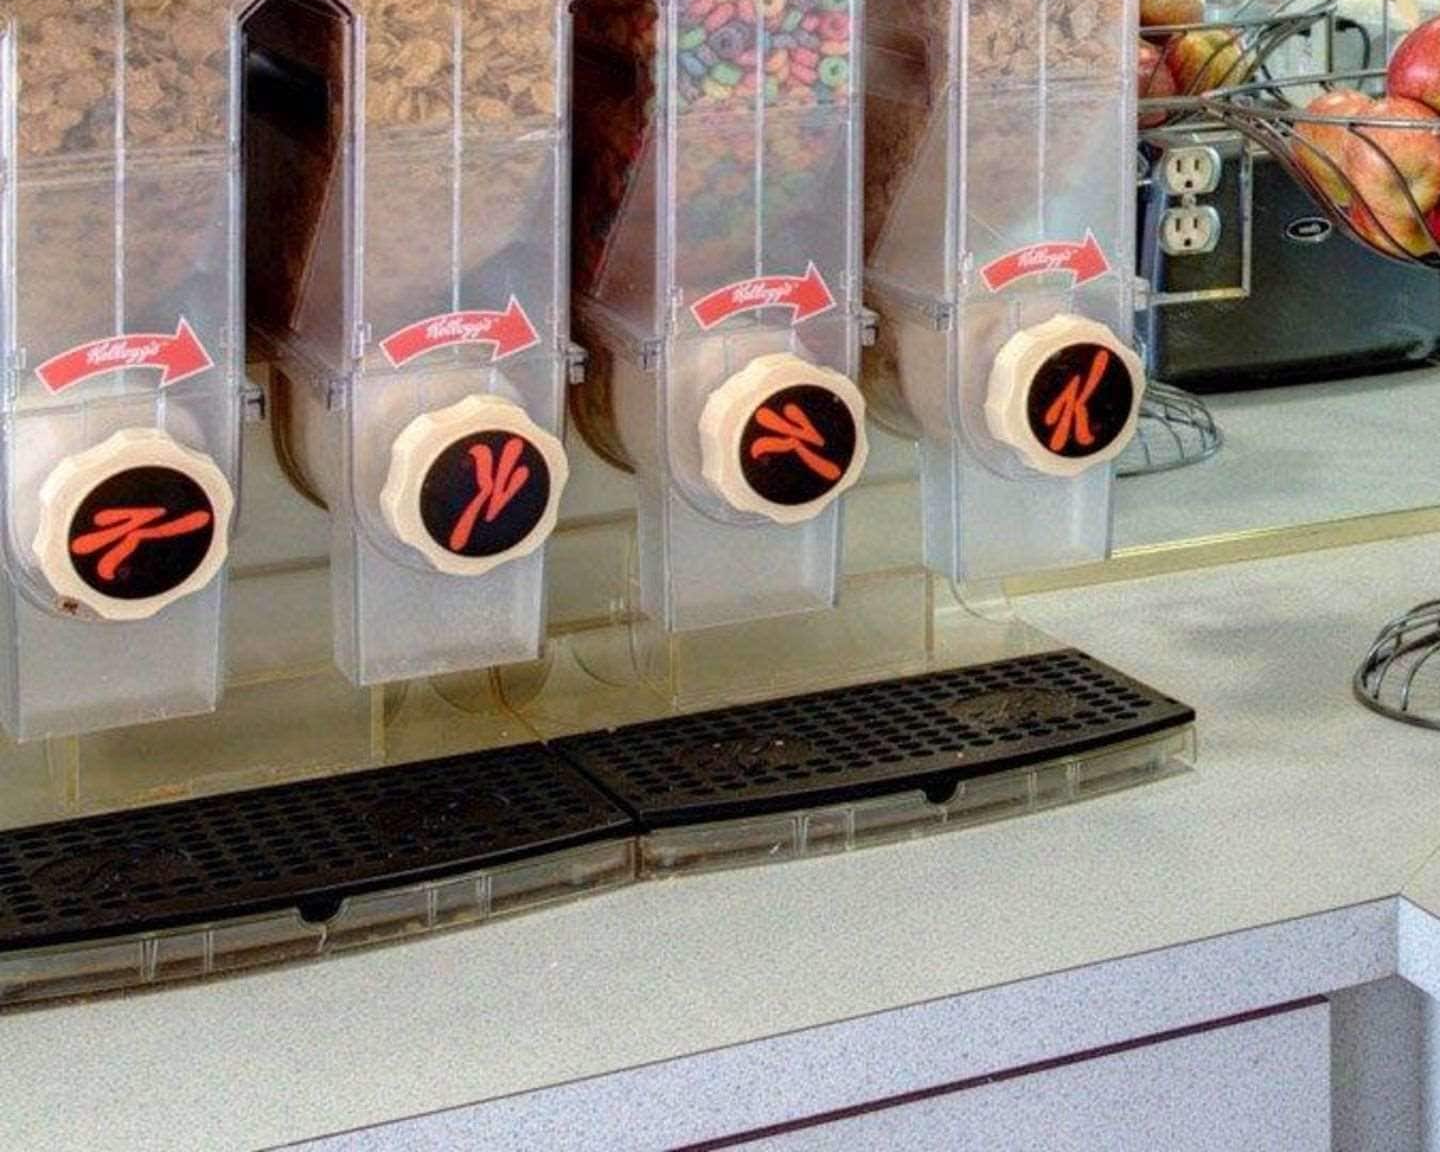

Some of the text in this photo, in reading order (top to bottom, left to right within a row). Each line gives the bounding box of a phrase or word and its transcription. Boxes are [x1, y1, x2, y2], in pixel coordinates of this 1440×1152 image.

[1017, 248, 1073, 269] Kellogg's
[732, 282, 793, 305] Kellogg's
[426, 318, 492, 339] Kellogg's
[86, 339, 160, 364] Kellogg's
[1044, 349, 1110, 452] K
